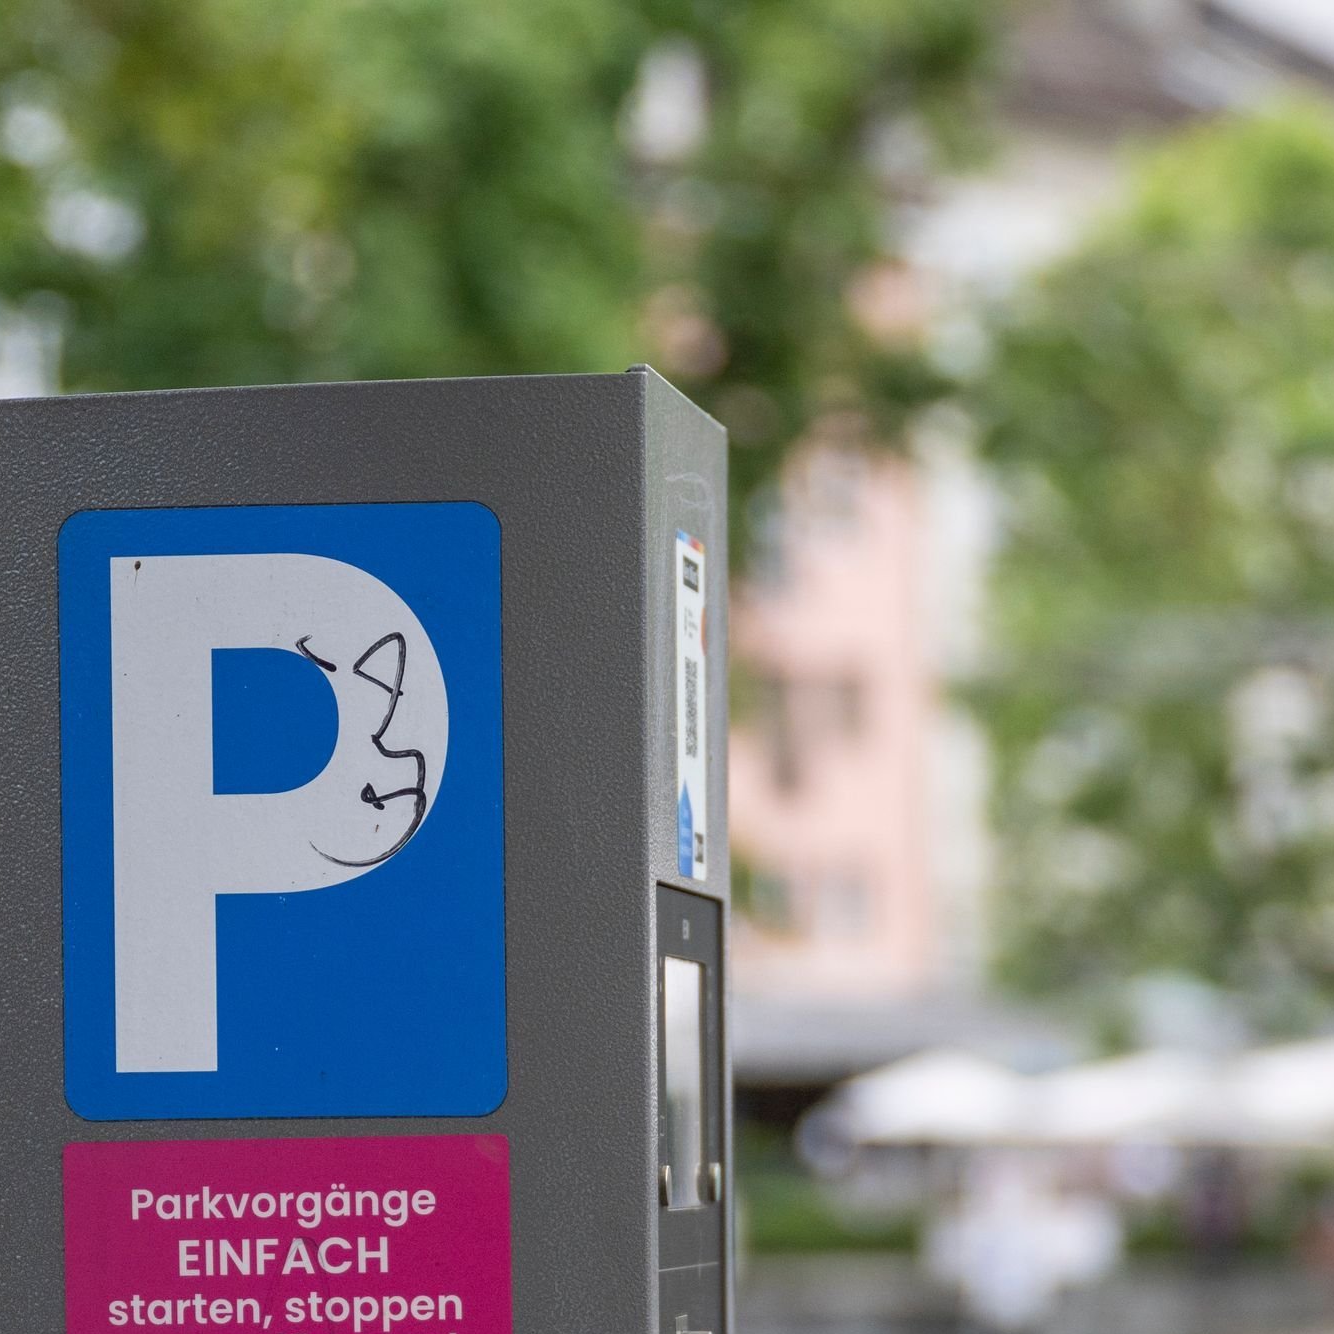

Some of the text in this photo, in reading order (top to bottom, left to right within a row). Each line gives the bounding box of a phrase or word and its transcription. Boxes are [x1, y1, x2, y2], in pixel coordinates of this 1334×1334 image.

[110, 553, 449, 1073] P
[131, 1183, 436, 1228] Parkvorgänge
[178, 1236, 389, 1277] EINFACH
[108, 1292, 463, 1333] starten, stoppen
